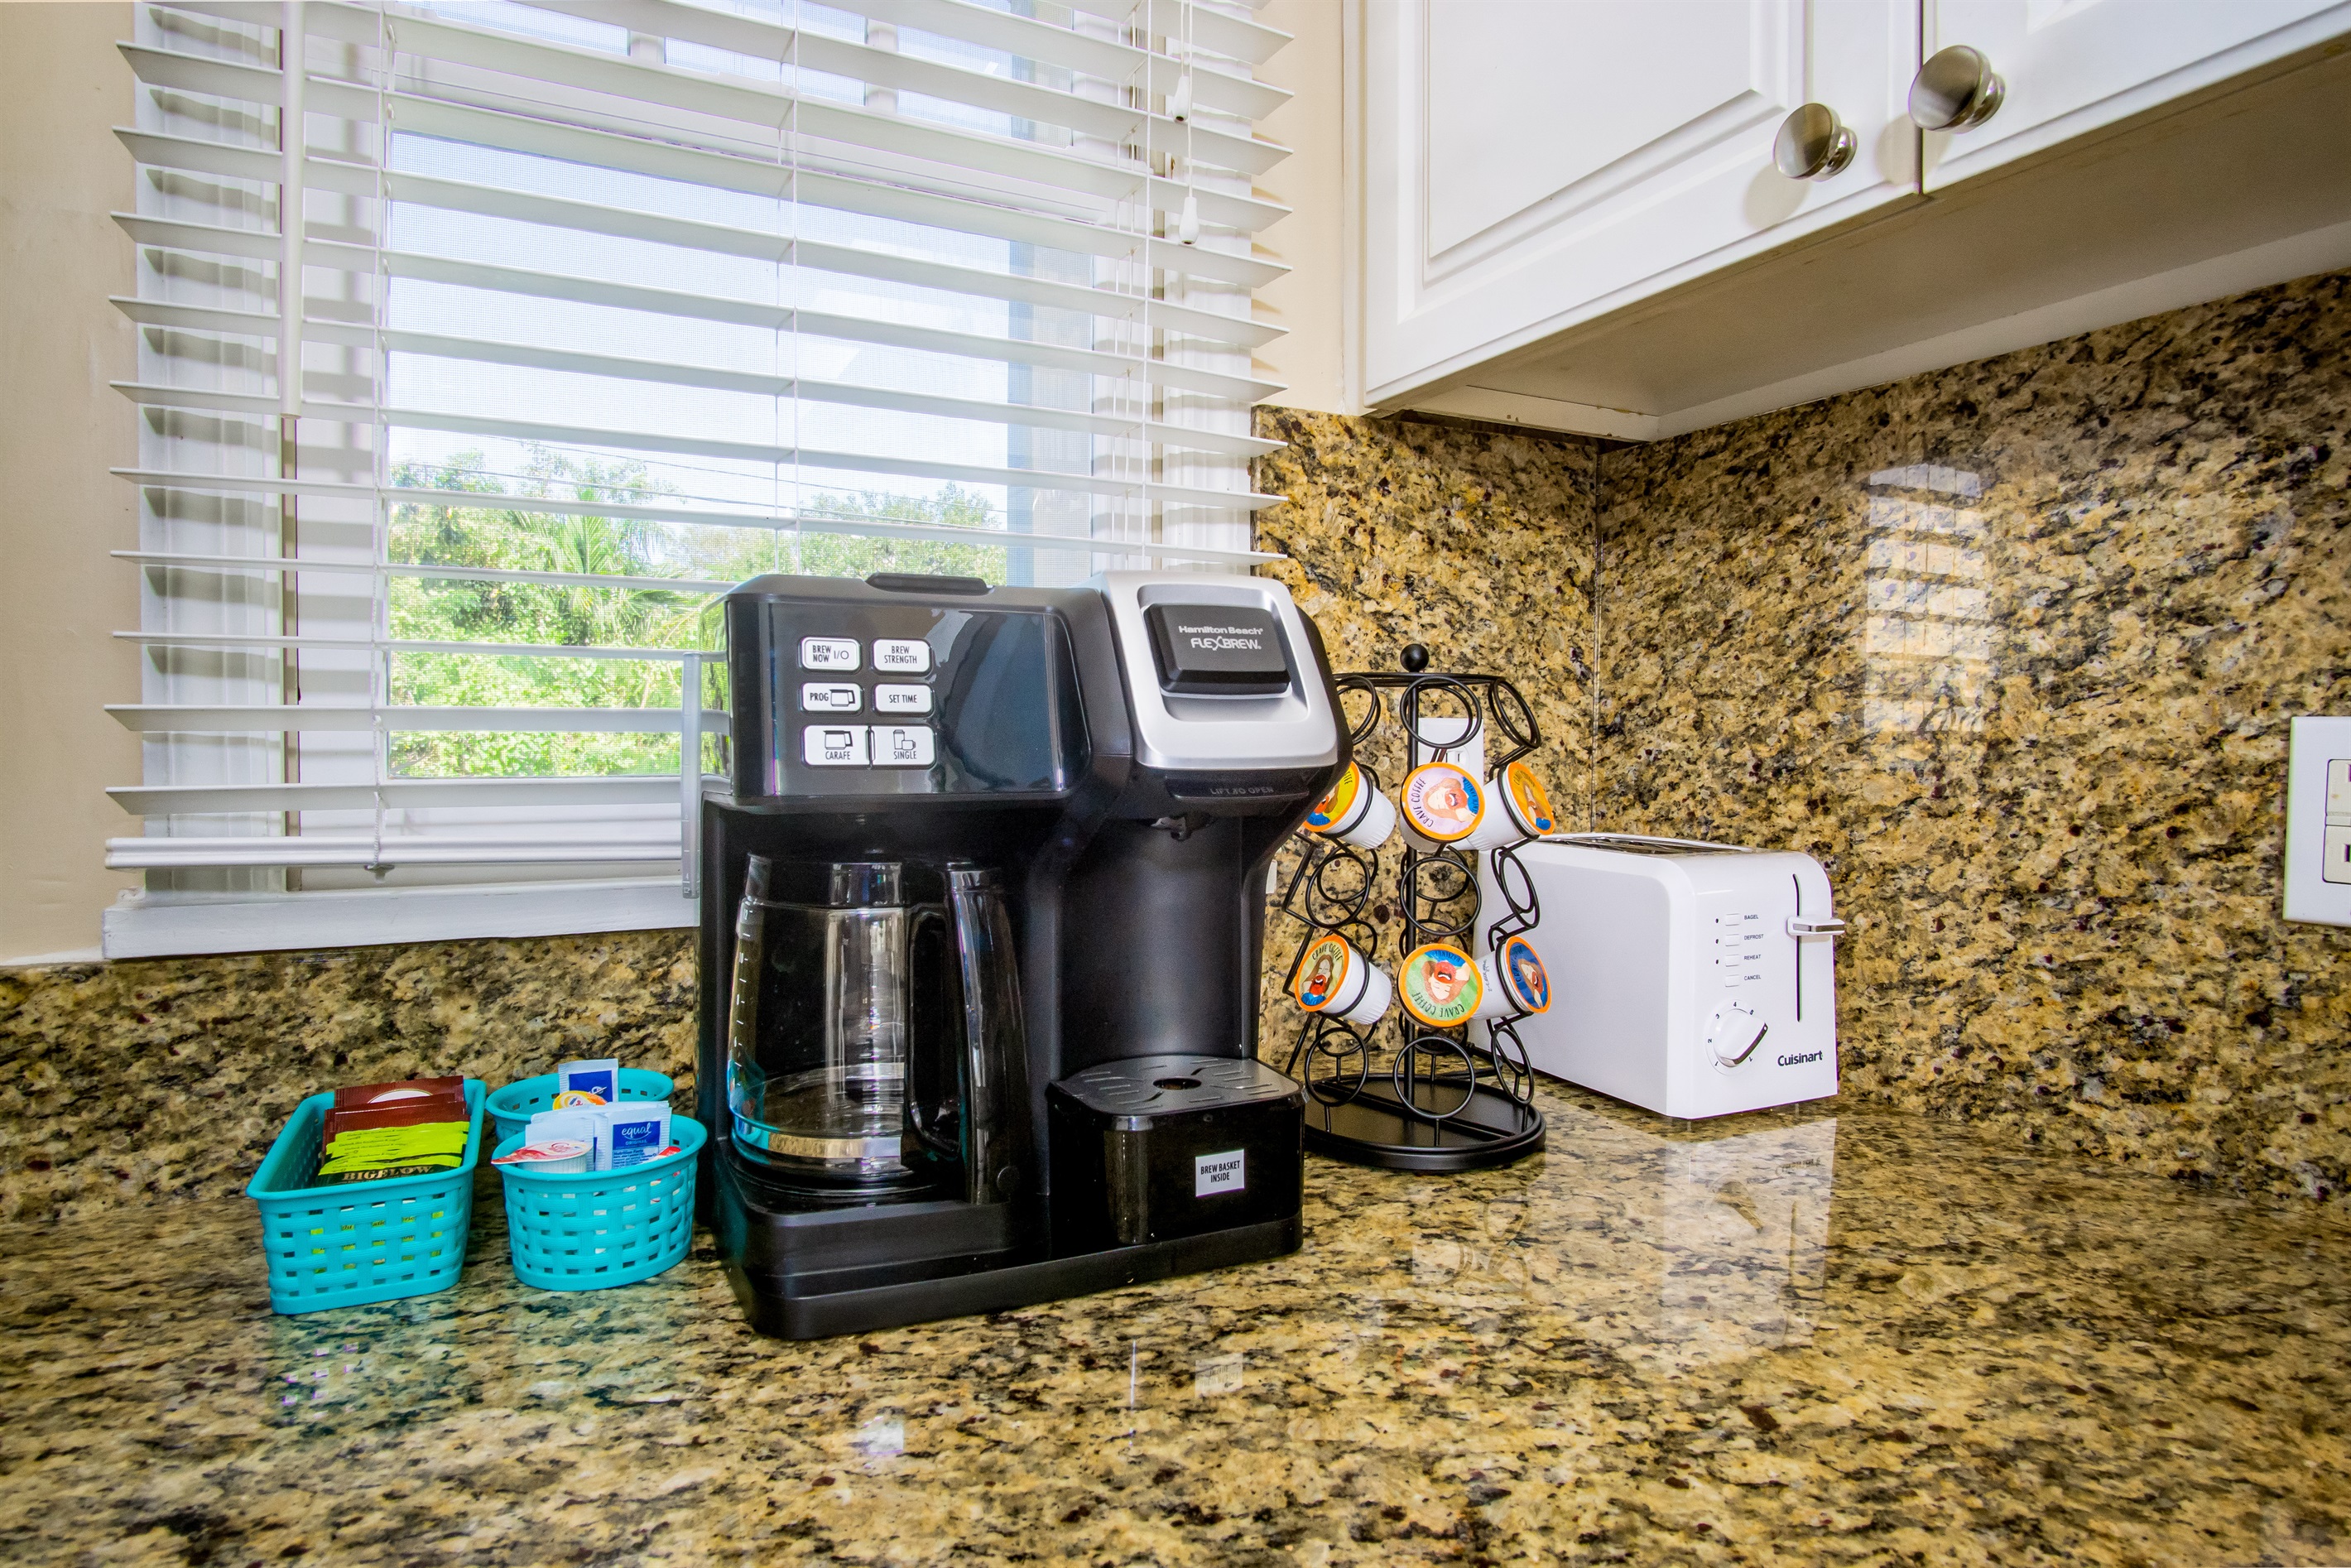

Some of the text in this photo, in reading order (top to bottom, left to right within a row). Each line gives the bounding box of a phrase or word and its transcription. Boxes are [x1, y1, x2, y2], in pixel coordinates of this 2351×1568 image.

[1178, 625, 1228, 634] Hamilton
[812, 645, 831, 654] BREW
[892, 646, 910, 654] BREW
[813, 654, 829, 662] NOW
[884, 656, 917, 664] STRENGTH
[810, 692, 829, 701] PROG
[889, 695, 917, 704] SET TIME
[825, 751, 851, 760] CARAFE
[893, 751, 917, 760] SINGLE
[1411, 777, 1434, 828] CRAVE COFFEE
[1411, 992, 1465, 1017] CRAVE COFFEE
[1777, 1051, 1823, 1067] Cuisinart
[621, 1122, 651, 1138] equal
[1200, 1160, 1240, 1175] BREW BASKET
[342, 1166, 433, 1181] BIGELOW
[1210, 1171, 1229, 1183] INSIDE
